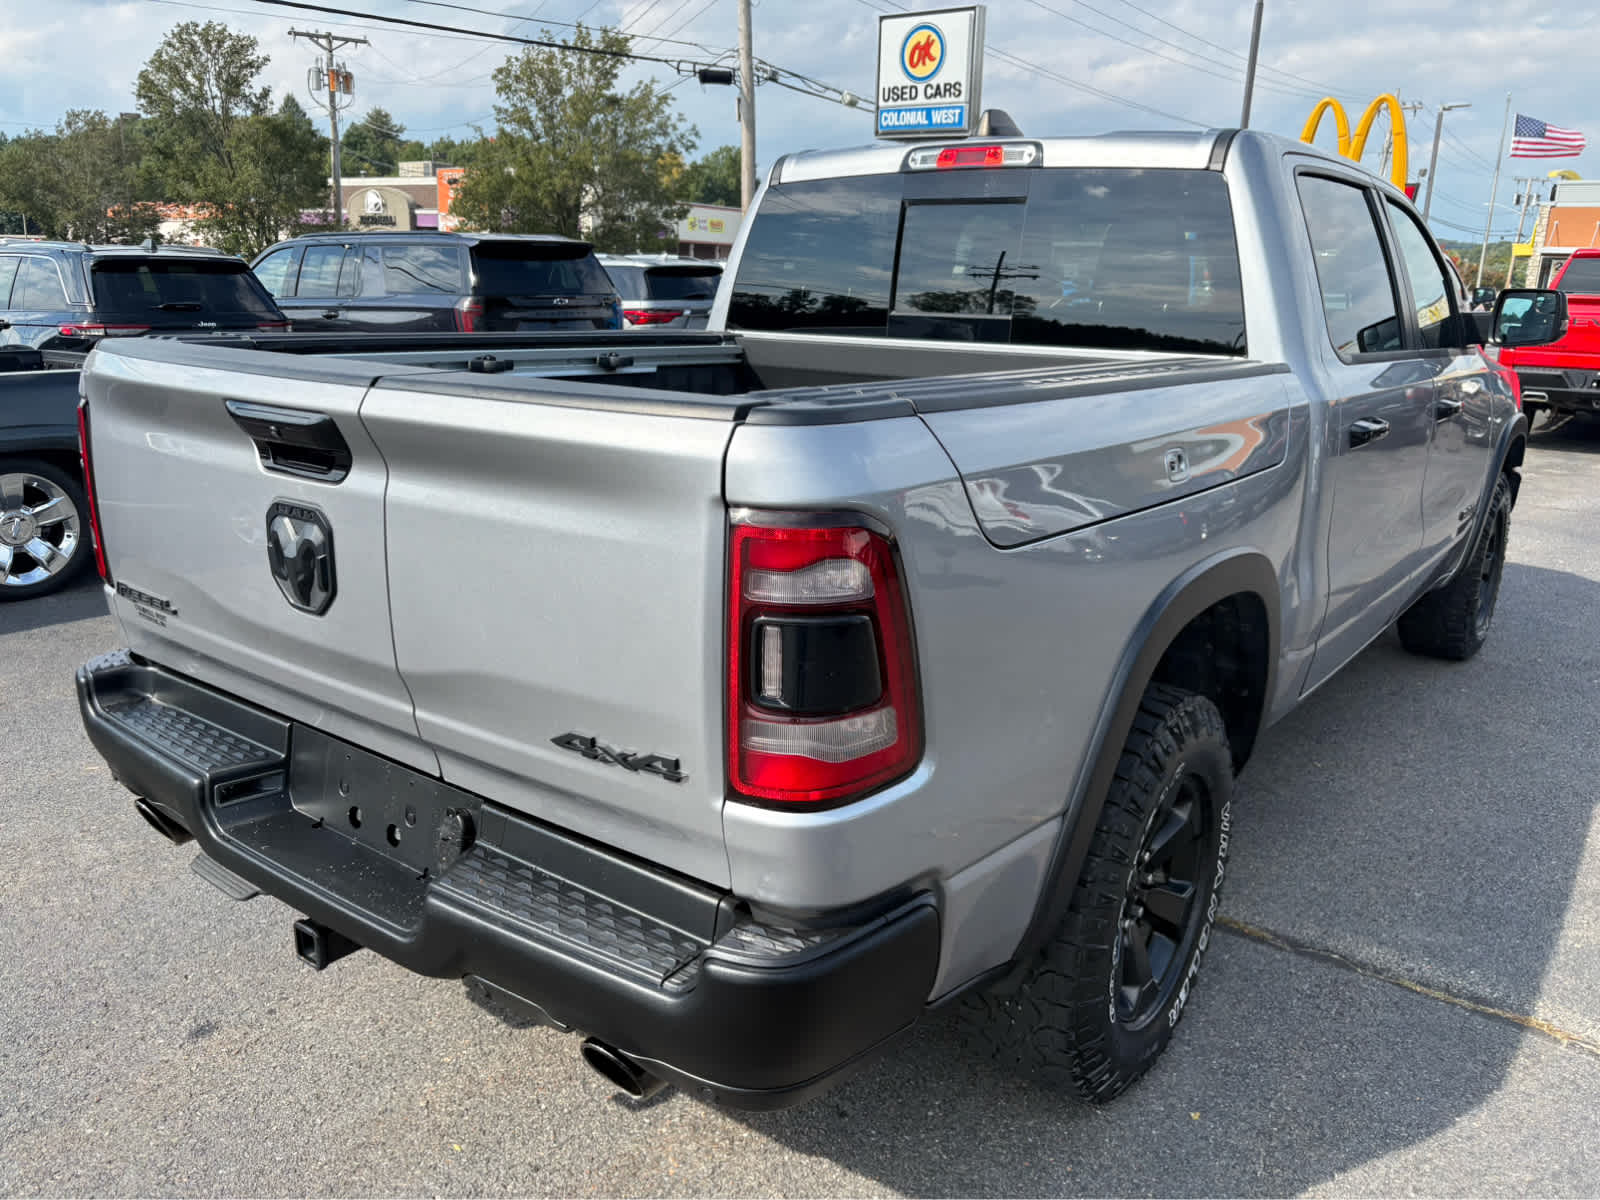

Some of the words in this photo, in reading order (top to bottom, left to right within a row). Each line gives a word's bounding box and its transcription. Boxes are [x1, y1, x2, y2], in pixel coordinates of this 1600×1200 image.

[909, 34, 936, 69] OK
[882, 85, 918, 102] USED
[924, 82, 962, 100] CARS
[881, 110, 928, 127] COLONIAL
[931, 109, 961, 124] WEST
